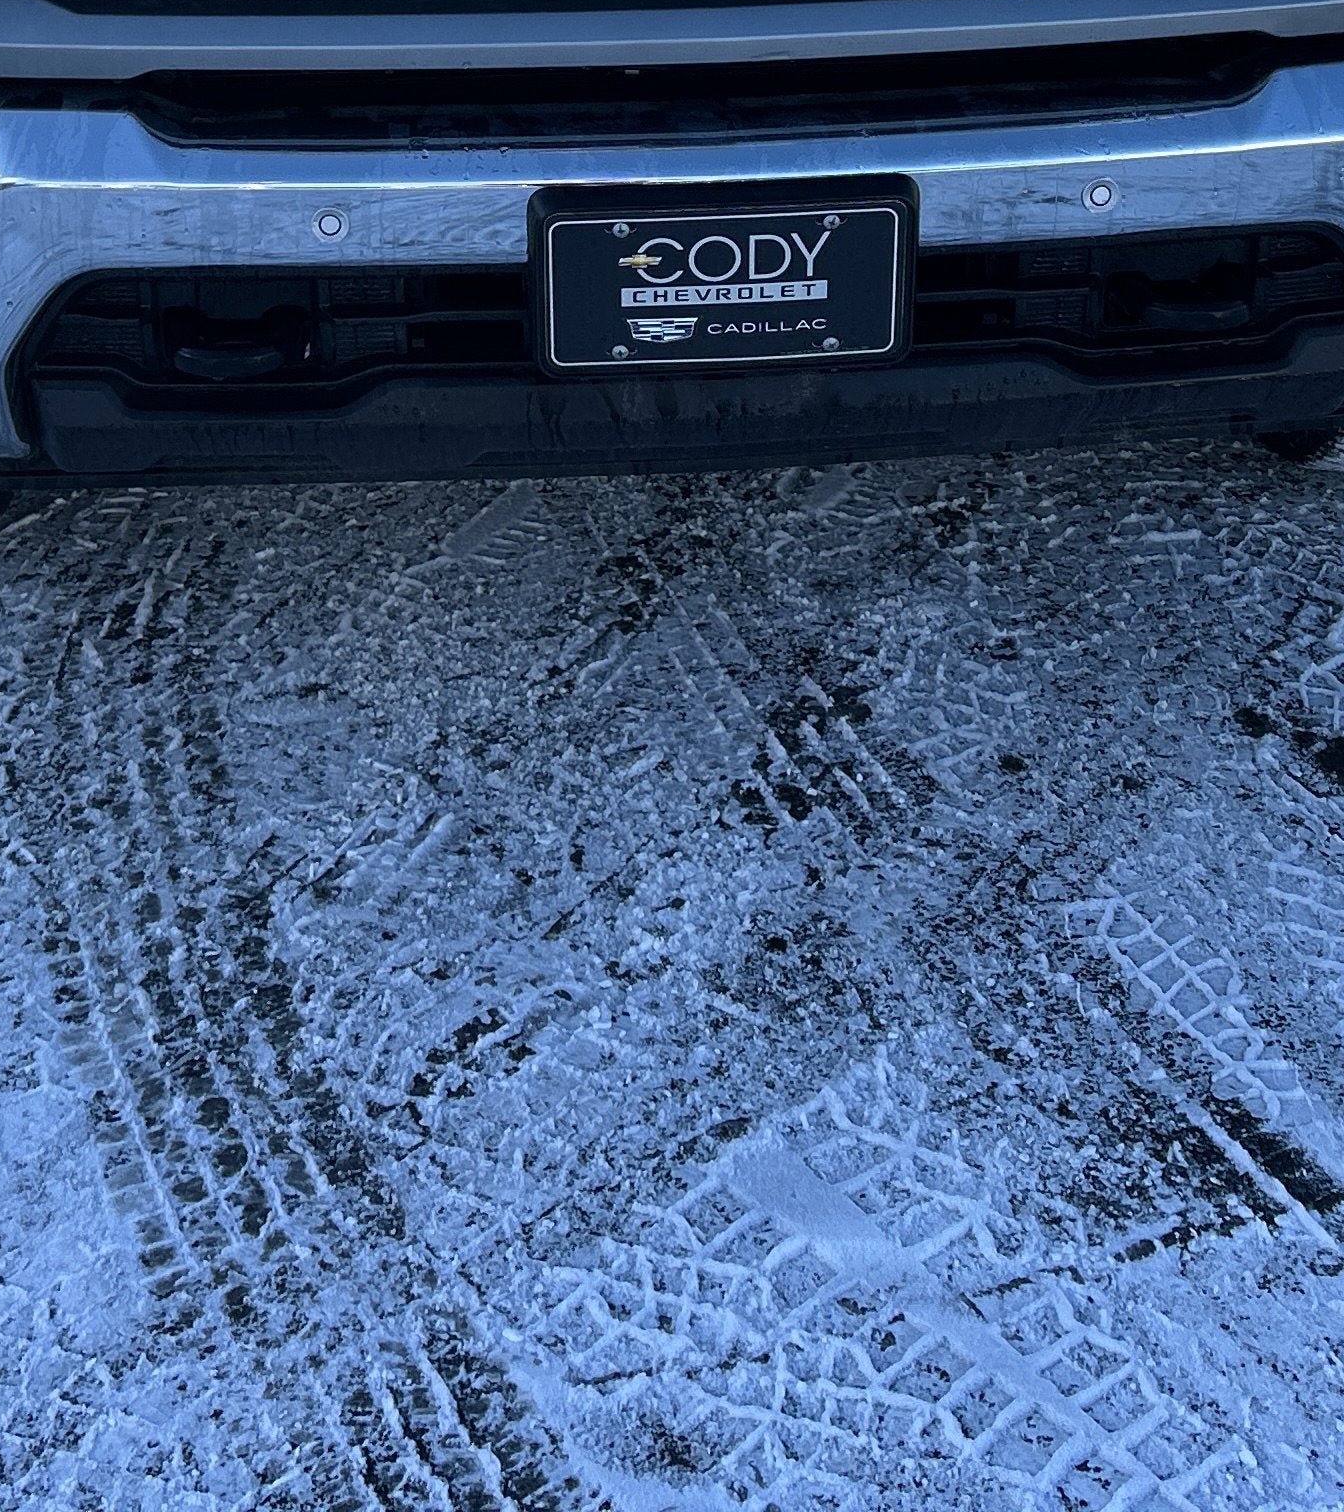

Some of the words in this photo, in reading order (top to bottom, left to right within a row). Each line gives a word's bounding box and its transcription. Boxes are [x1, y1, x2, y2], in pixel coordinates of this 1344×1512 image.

[636, 231, 831, 284] CODY
[631, 283, 817, 304] CHEVROLET
[706, 318, 827, 335] CADILLAC
